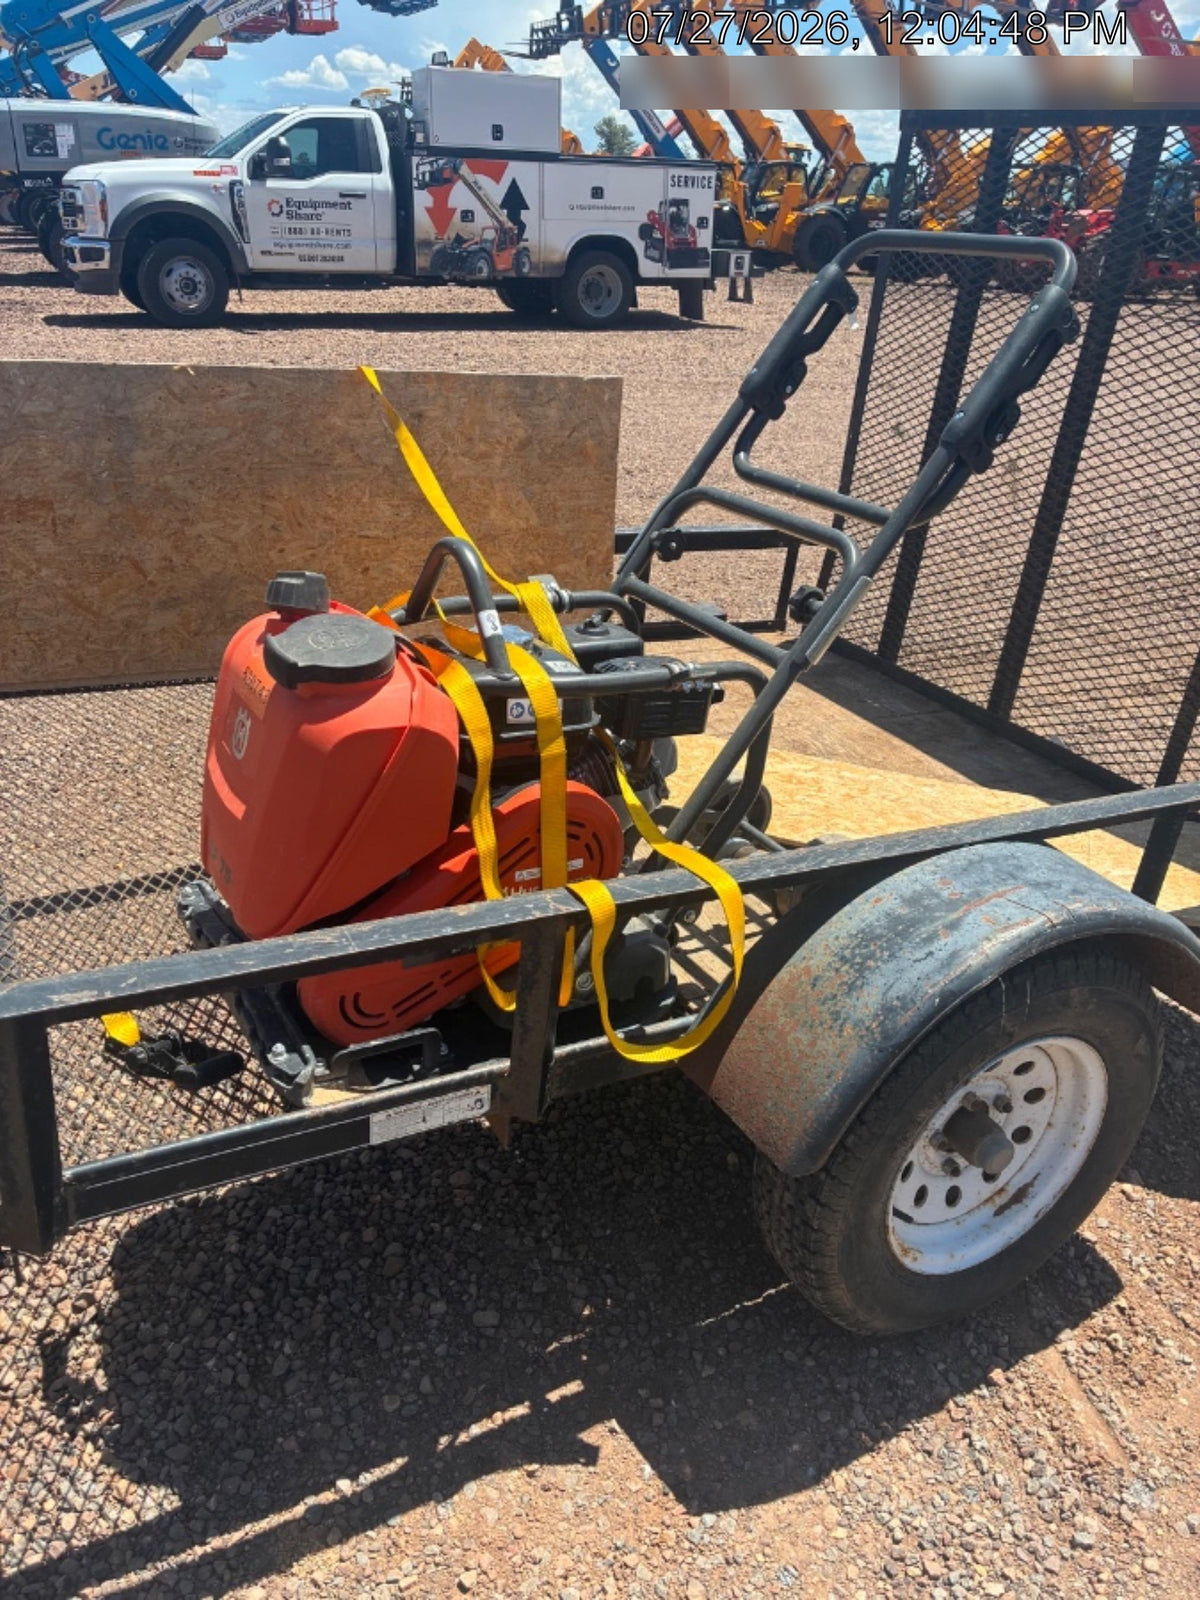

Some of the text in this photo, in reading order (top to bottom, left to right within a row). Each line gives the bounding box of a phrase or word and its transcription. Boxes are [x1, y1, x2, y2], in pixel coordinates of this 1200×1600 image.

[96, 127, 168, 150] Genie
[670, 174, 713, 189] SERVICE
[285, 197, 352, 210] Equipment
[286, 210, 322, 221] Share
